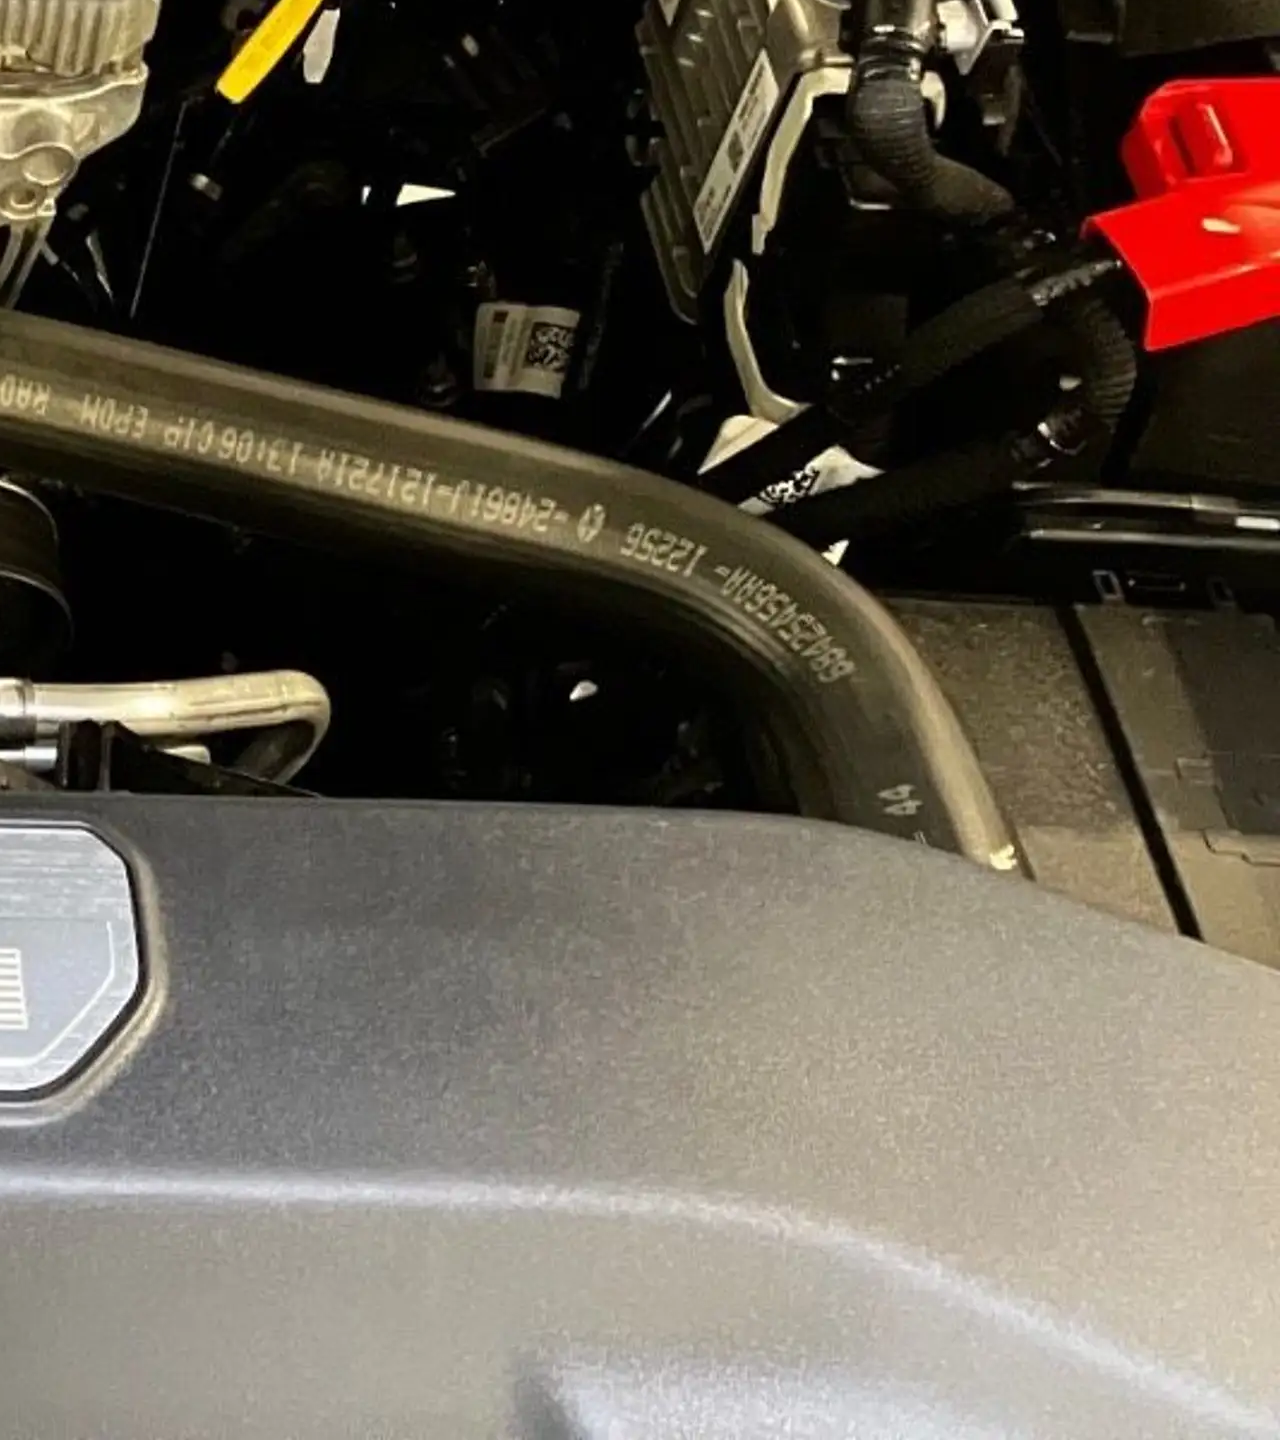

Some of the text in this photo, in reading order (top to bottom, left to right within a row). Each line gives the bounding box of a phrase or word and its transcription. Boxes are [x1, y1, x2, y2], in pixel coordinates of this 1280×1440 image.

[0, 373, 51, 417] RAD
[80, 394, 149, 438] EPDM
[620, 522, 709, 579] 12256
